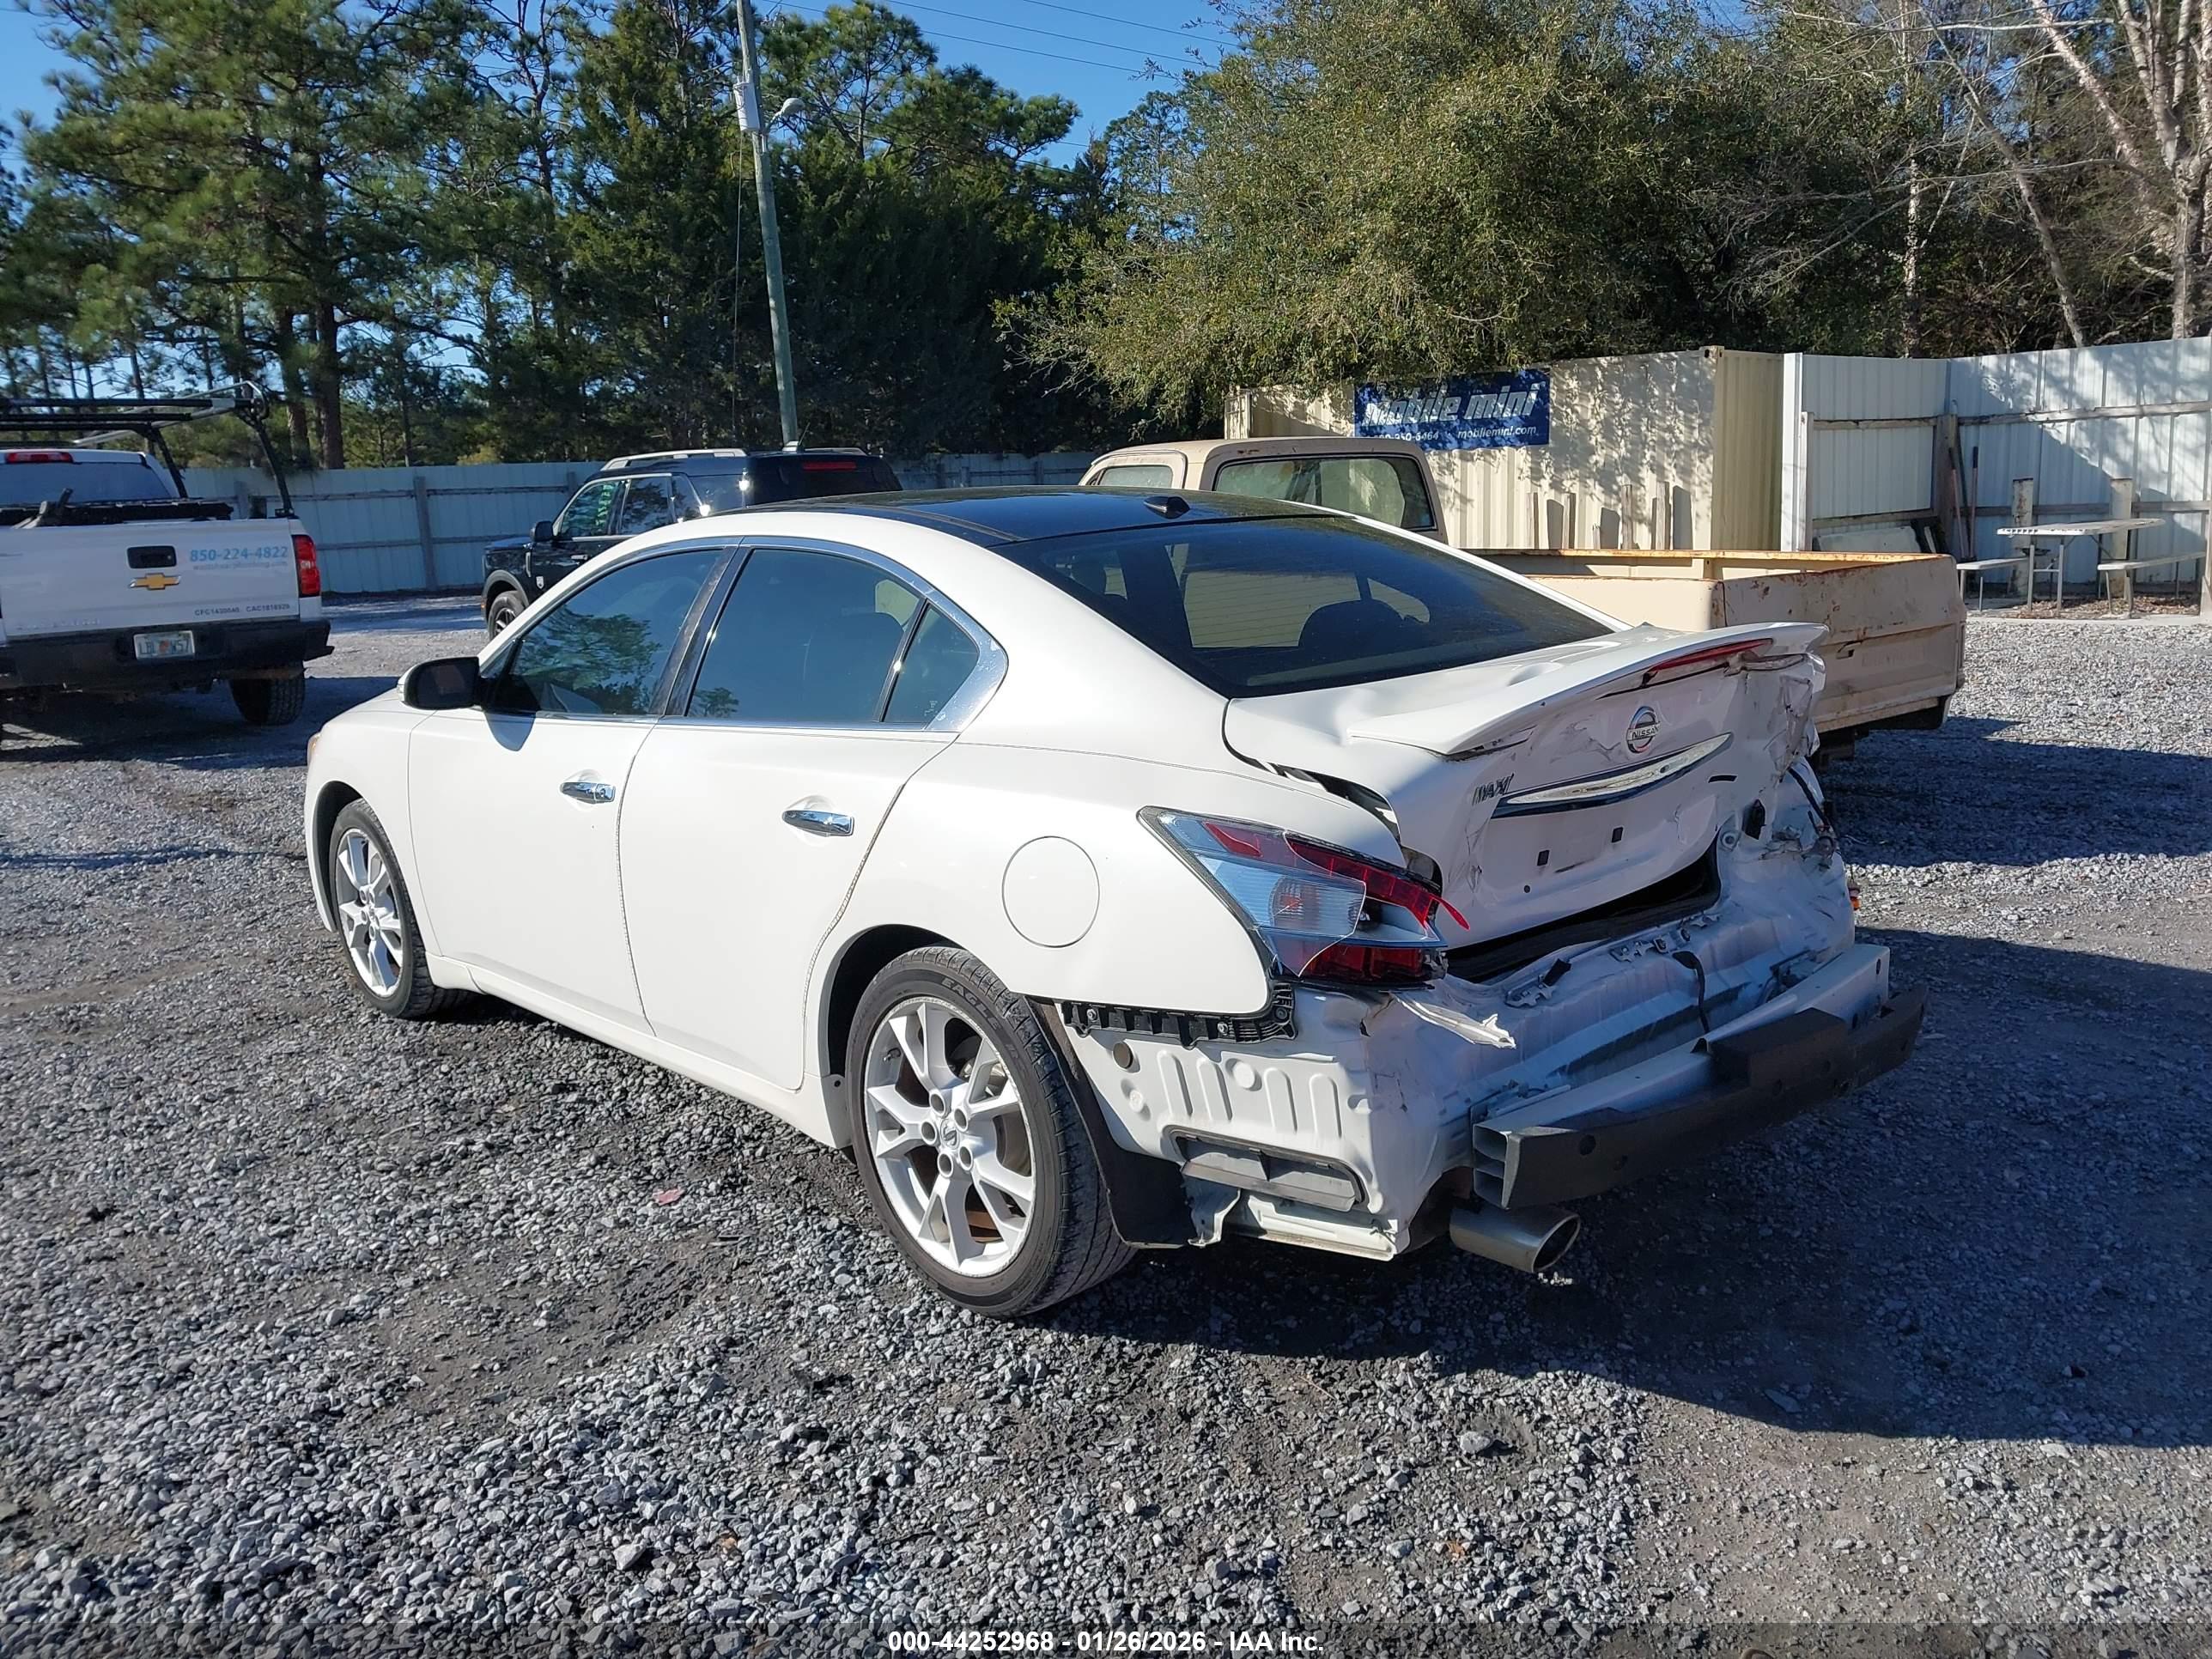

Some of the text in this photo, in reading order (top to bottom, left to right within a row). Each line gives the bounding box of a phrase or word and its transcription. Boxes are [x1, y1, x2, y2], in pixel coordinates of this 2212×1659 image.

[1361, 382, 1545, 427] mobile mini
[1457, 425, 1536, 440] mobilemini.com
[190, 546, 289, 562] 850-224-4822
[1632, 725, 1659, 739] NISSAN
[941, 977, 1004, 1031] EAGLE
